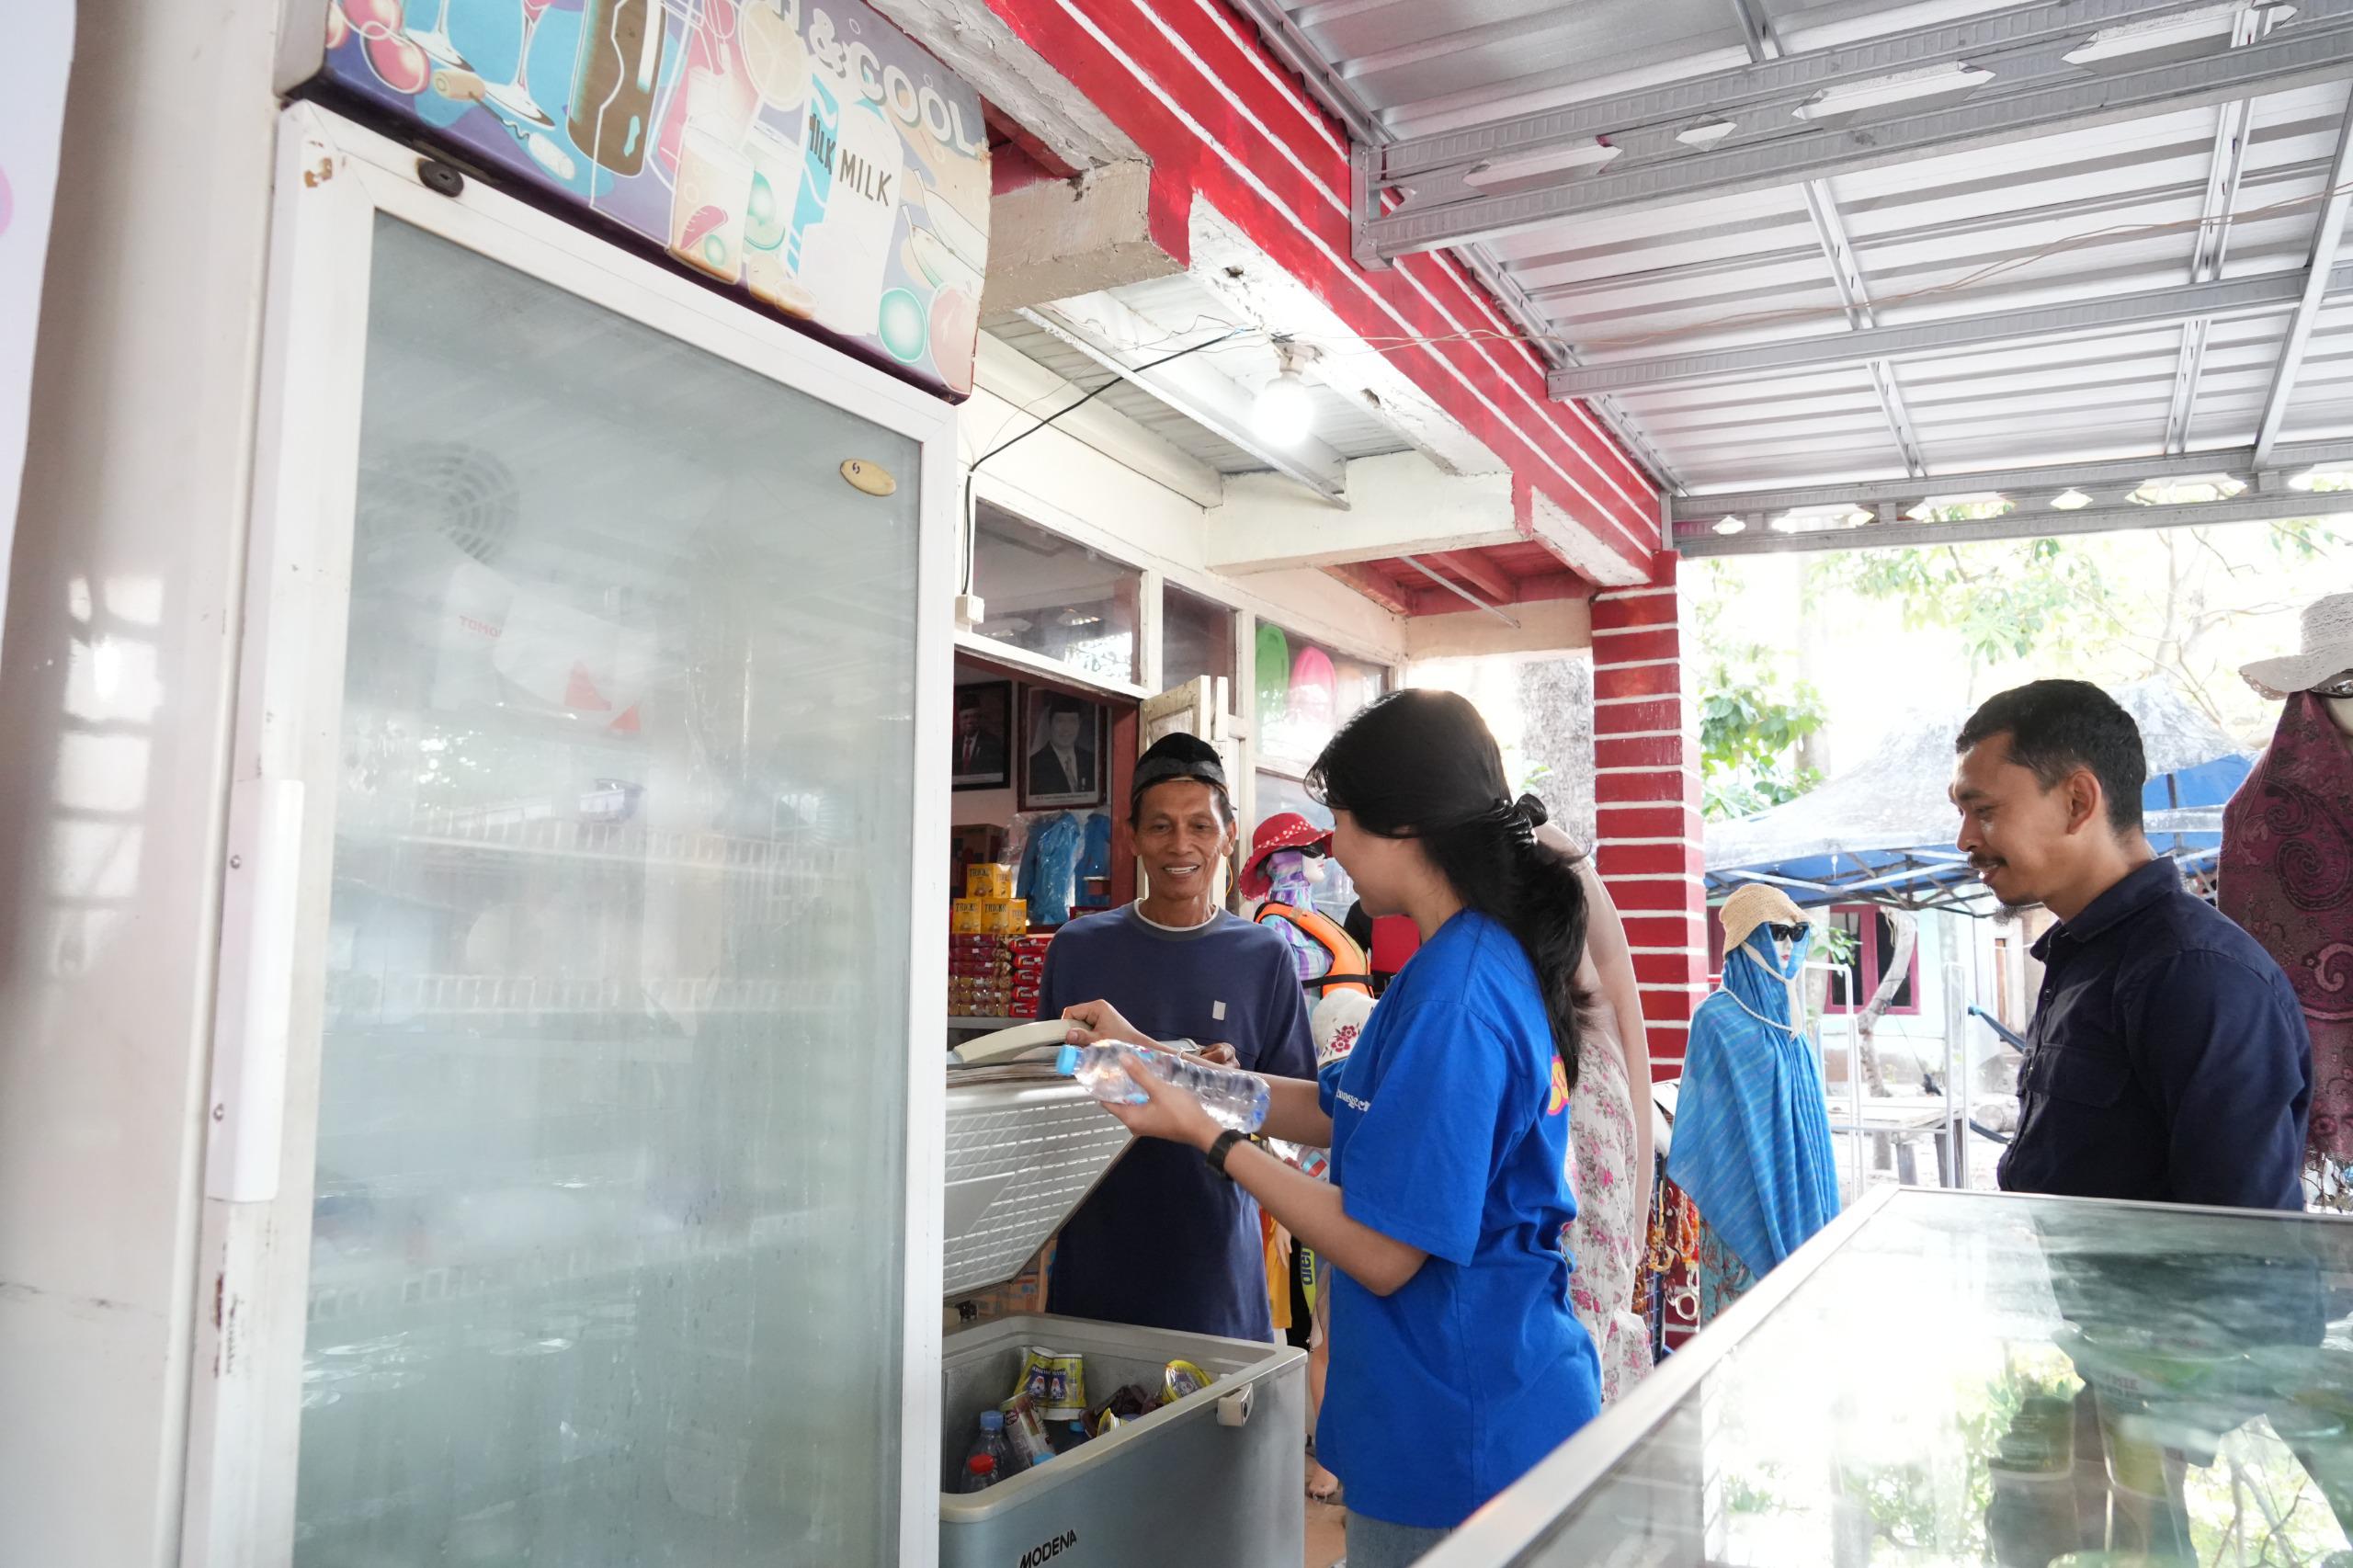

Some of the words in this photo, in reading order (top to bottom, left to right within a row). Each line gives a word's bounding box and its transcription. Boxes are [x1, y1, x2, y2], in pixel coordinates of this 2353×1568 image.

[847, 40, 980, 160] COOL
[839, 148, 892, 207] MILK
[1019, 1528, 1077, 1568] MODENA
